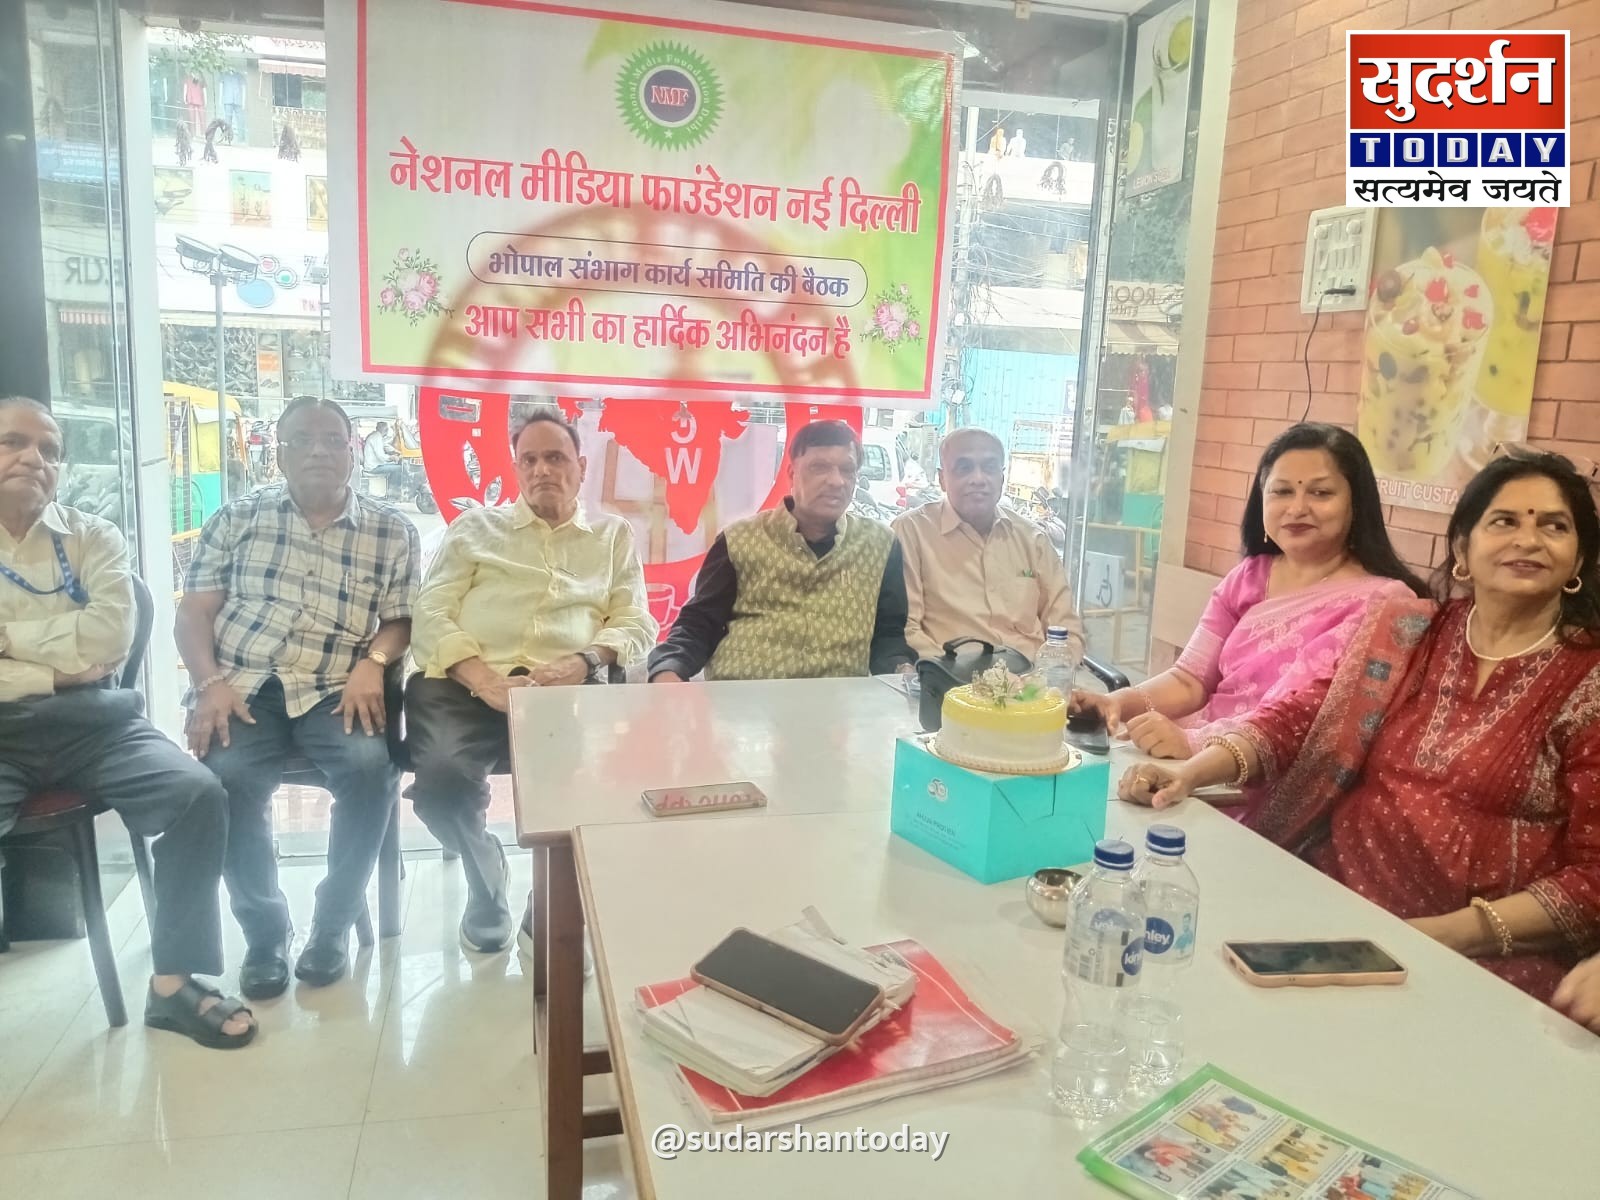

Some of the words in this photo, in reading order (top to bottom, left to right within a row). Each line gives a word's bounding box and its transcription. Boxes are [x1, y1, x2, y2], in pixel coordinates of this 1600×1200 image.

[389, 136, 513, 198] नेशनल
[520, 148, 633, 209] मीडिया
[641, 164, 780, 222] फाउंडेशन
[786, 176, 834, 231] नई
[839, 176, 921, 233] दिल्ली
[489, 244, 563, 278] भोपाल
[568, 251, 640, 283] संभाग
[644, 258, 692, 287] कार्य
[696, 260, 765, 292] समिति
[770, 265, 798, 294] की
[802, 267, 849, 297] बैठक
[465, 305, 520, 338] आप
[525, 297, 586, 342] सभी
[592, 313, 627, 344] का
[633, 303, 711, 350] हार्दिक
[716, 309, 829, 357] अभिनंदन
[834, 316, 851, 359] है
